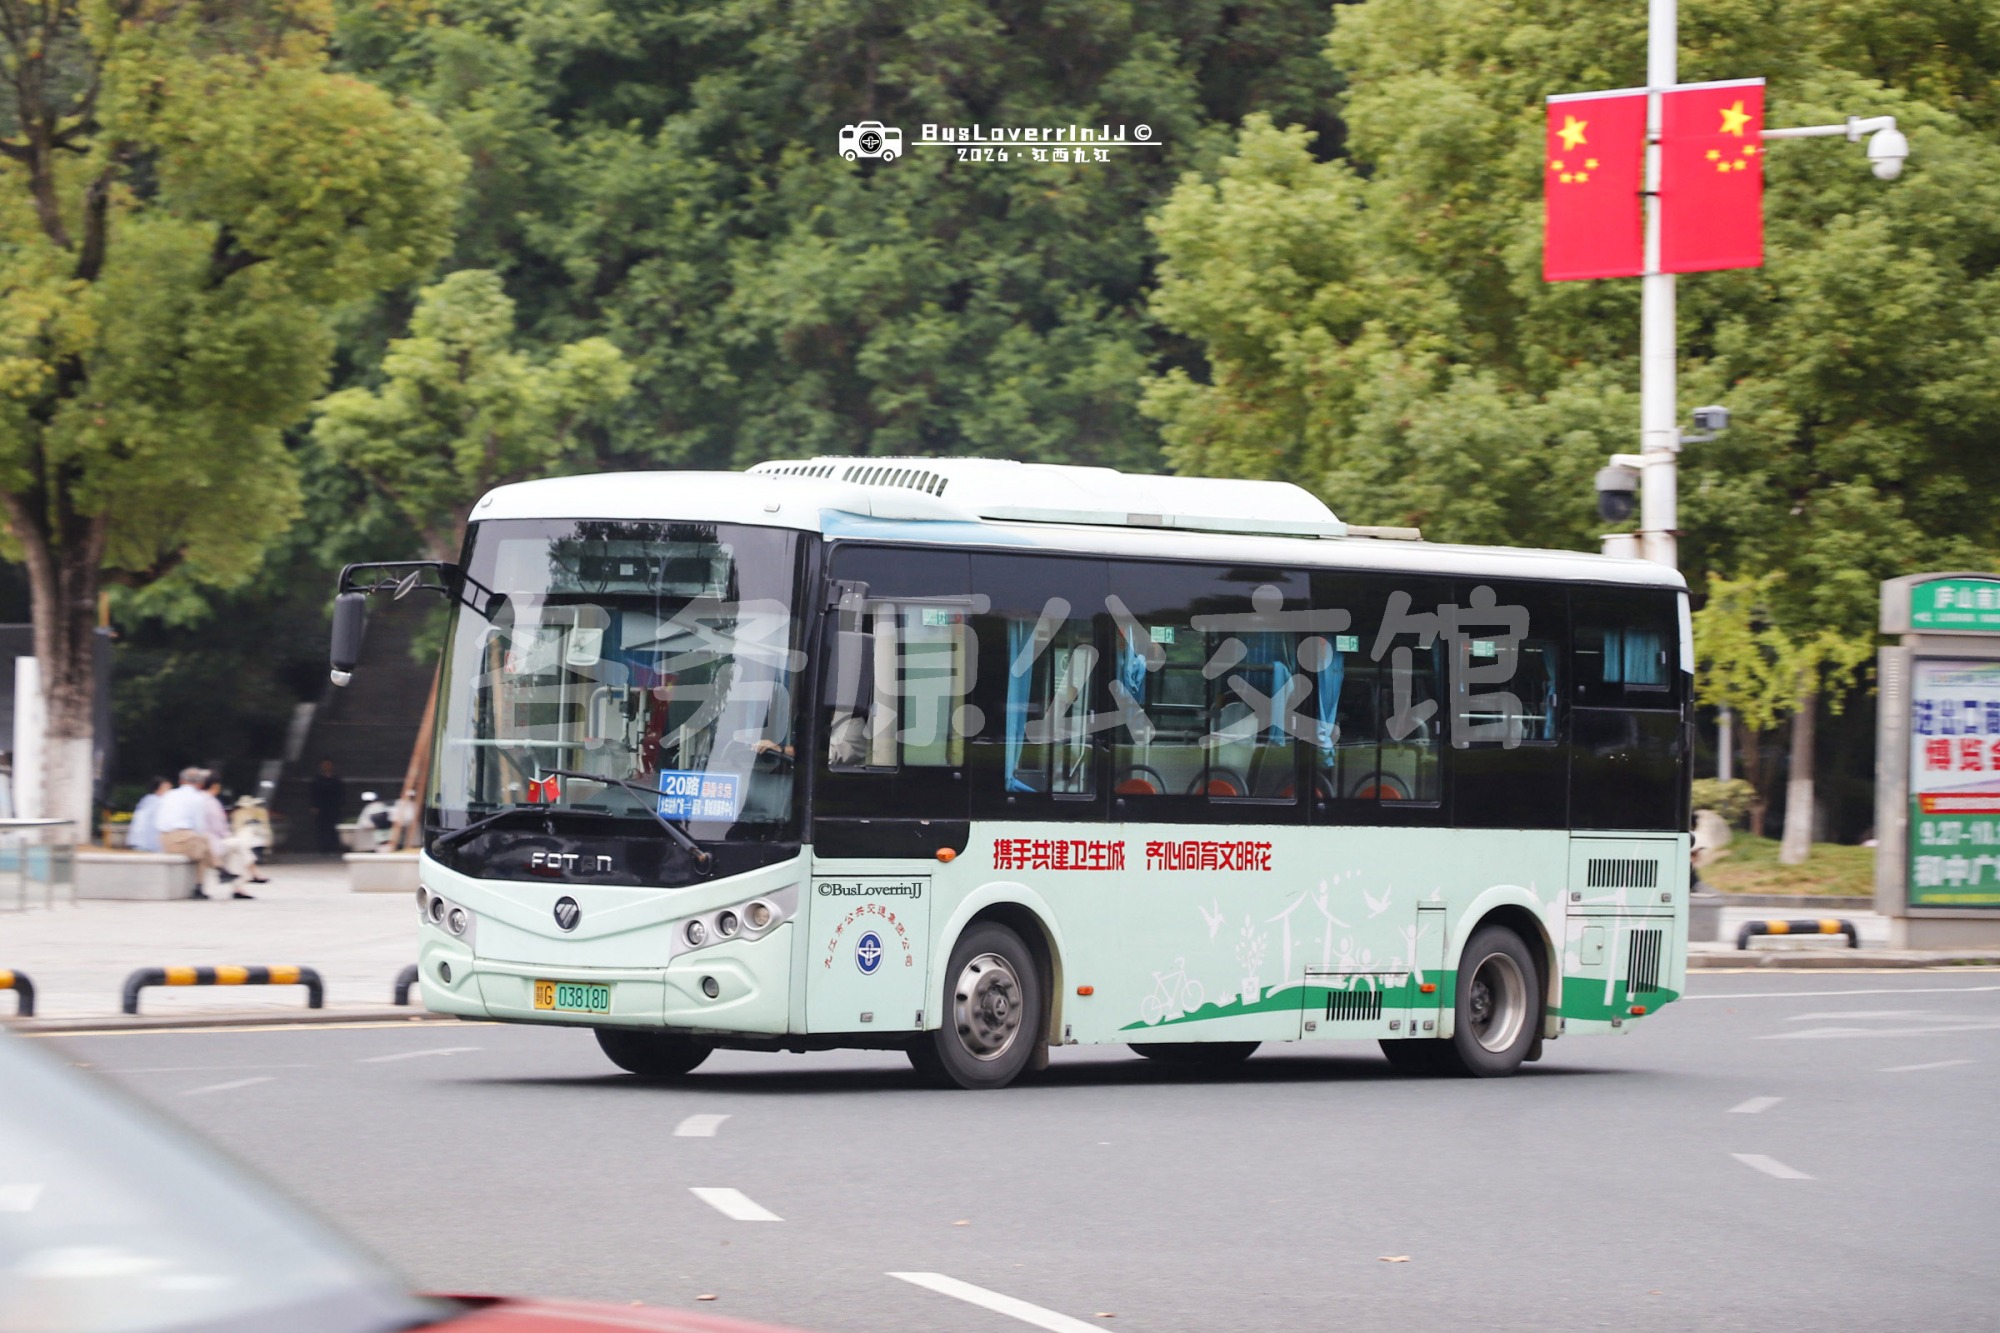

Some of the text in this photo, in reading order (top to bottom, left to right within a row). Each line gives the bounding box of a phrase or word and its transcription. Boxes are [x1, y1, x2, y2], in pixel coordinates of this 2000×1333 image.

[1934, 586, 2000, 610] 庐山南
[531, 853, 612, 872] FOTN
[993, 839, 1272, 871] 携手共建卫生城 齐心同育文明花
